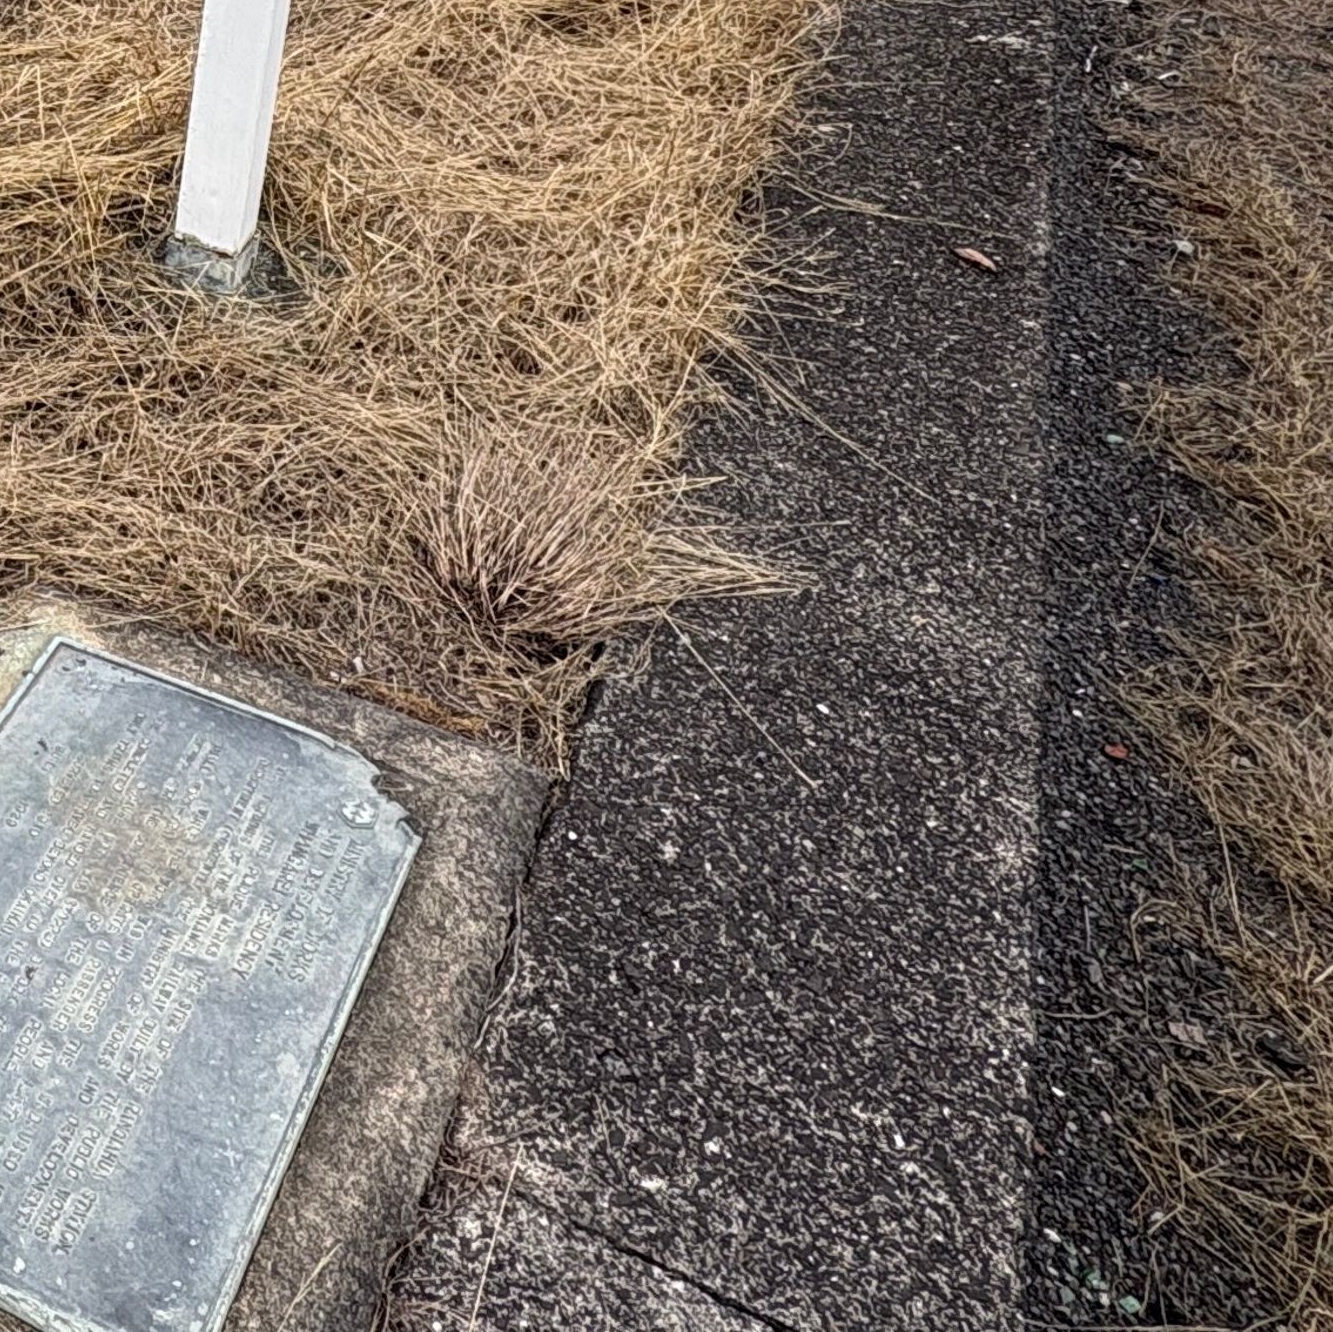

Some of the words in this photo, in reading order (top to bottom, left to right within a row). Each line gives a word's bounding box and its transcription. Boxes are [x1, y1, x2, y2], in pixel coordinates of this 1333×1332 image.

[271, 818, 319, 897] WHANGAREI
[39, 875, 67, 908] OVER
[84, 912, 103, 932] OF
[203, 915, 234, 959] MARKS
[65, 936, 89, 964] THE
[230, 898, 281, 981] RESIDENCY
[138, 929, 177, 988] MINISTRY
[52, 957, 102, 1033] PASSENGER
[186, 965, 209, 993] THE
[76, 965, 122, 1033] PROGRESS
[124, 993, 143, 1014] OF
[30, 1039, 56, 1071] AND
[57, 1037, 83, 1068] THE
[94, 1020, 129, 1069] WORKS
[153, 1036, 173, 1058] OF
[75, 1075, 100, 1105] AND
[31, 1186, 71, 1242] WORKS
